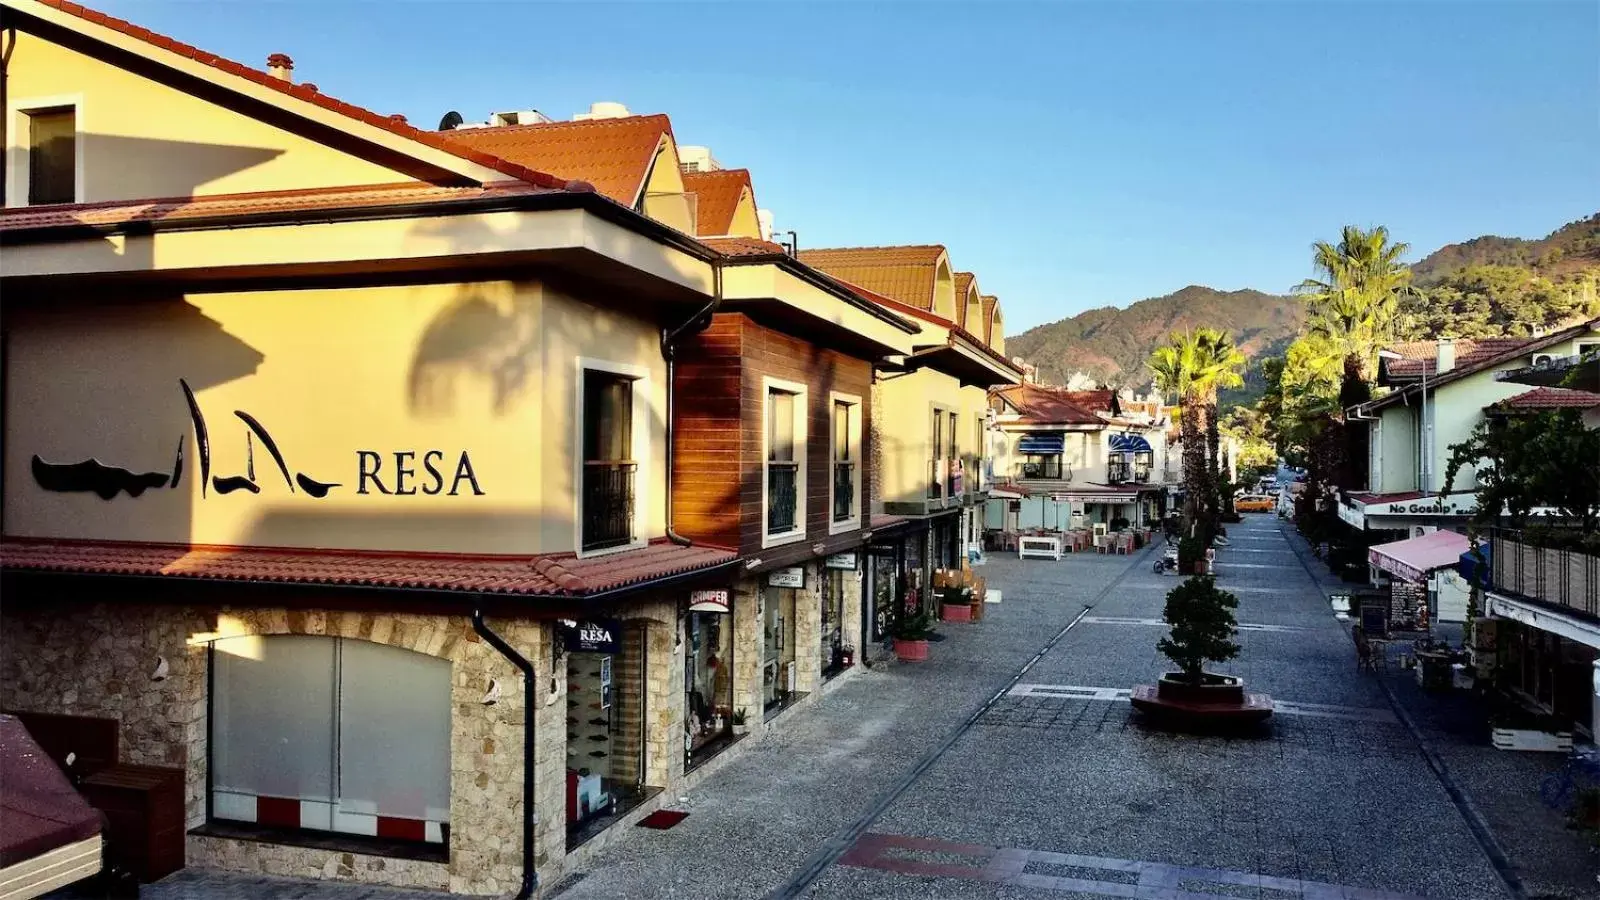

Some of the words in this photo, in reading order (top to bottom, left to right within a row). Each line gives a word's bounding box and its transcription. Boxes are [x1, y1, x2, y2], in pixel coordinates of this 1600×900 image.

[356, 450, 486, 496] RESA
[1389, 503, 1406, 514] No
[690, 590, 728, 605] CAMPER
[580, 629, 613, 643] RESA
